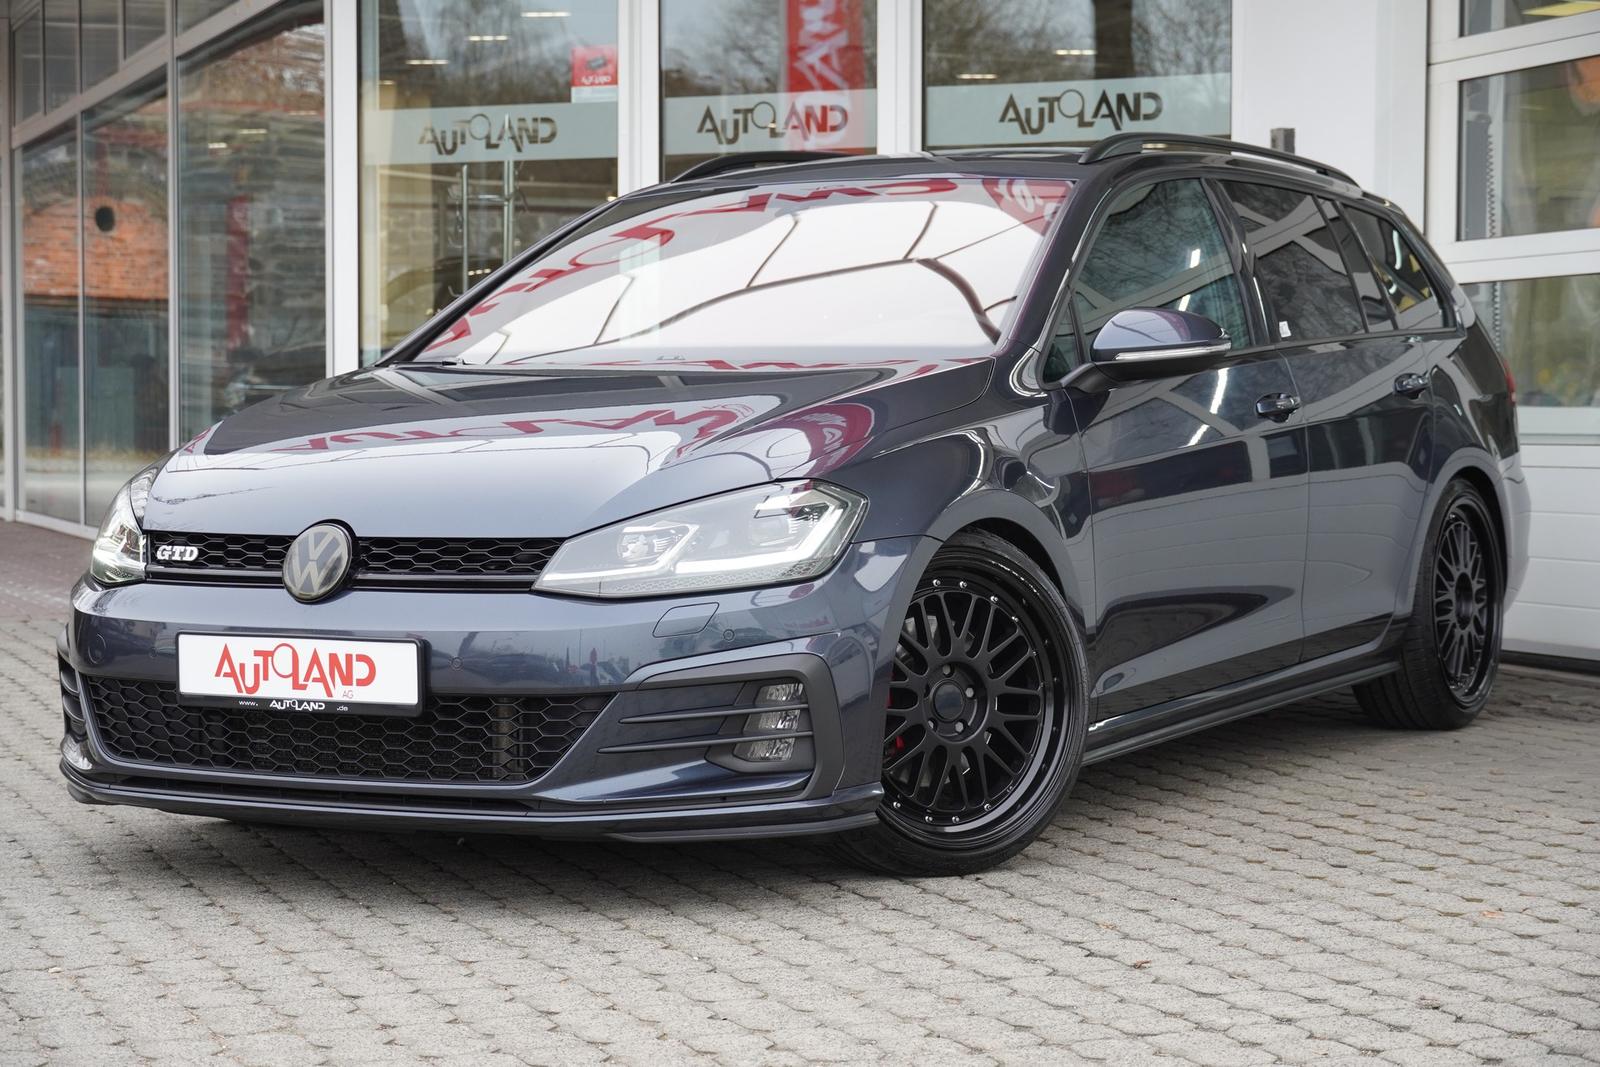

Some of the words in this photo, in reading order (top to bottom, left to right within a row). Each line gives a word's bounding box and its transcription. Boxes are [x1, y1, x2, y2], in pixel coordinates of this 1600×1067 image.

[697, 101, 849, 145] AUTOLAND
[999, 89, 1163, 136] AUTOLAND
[418, 113, 558, 156] AUTOLAND
[156, 545, 199, 562] GTD
[214, 643, 377, 698] AUTOLAND
[269, 699, 326, 712] AUTOLAND
[342, 690, 354, 699] AG
